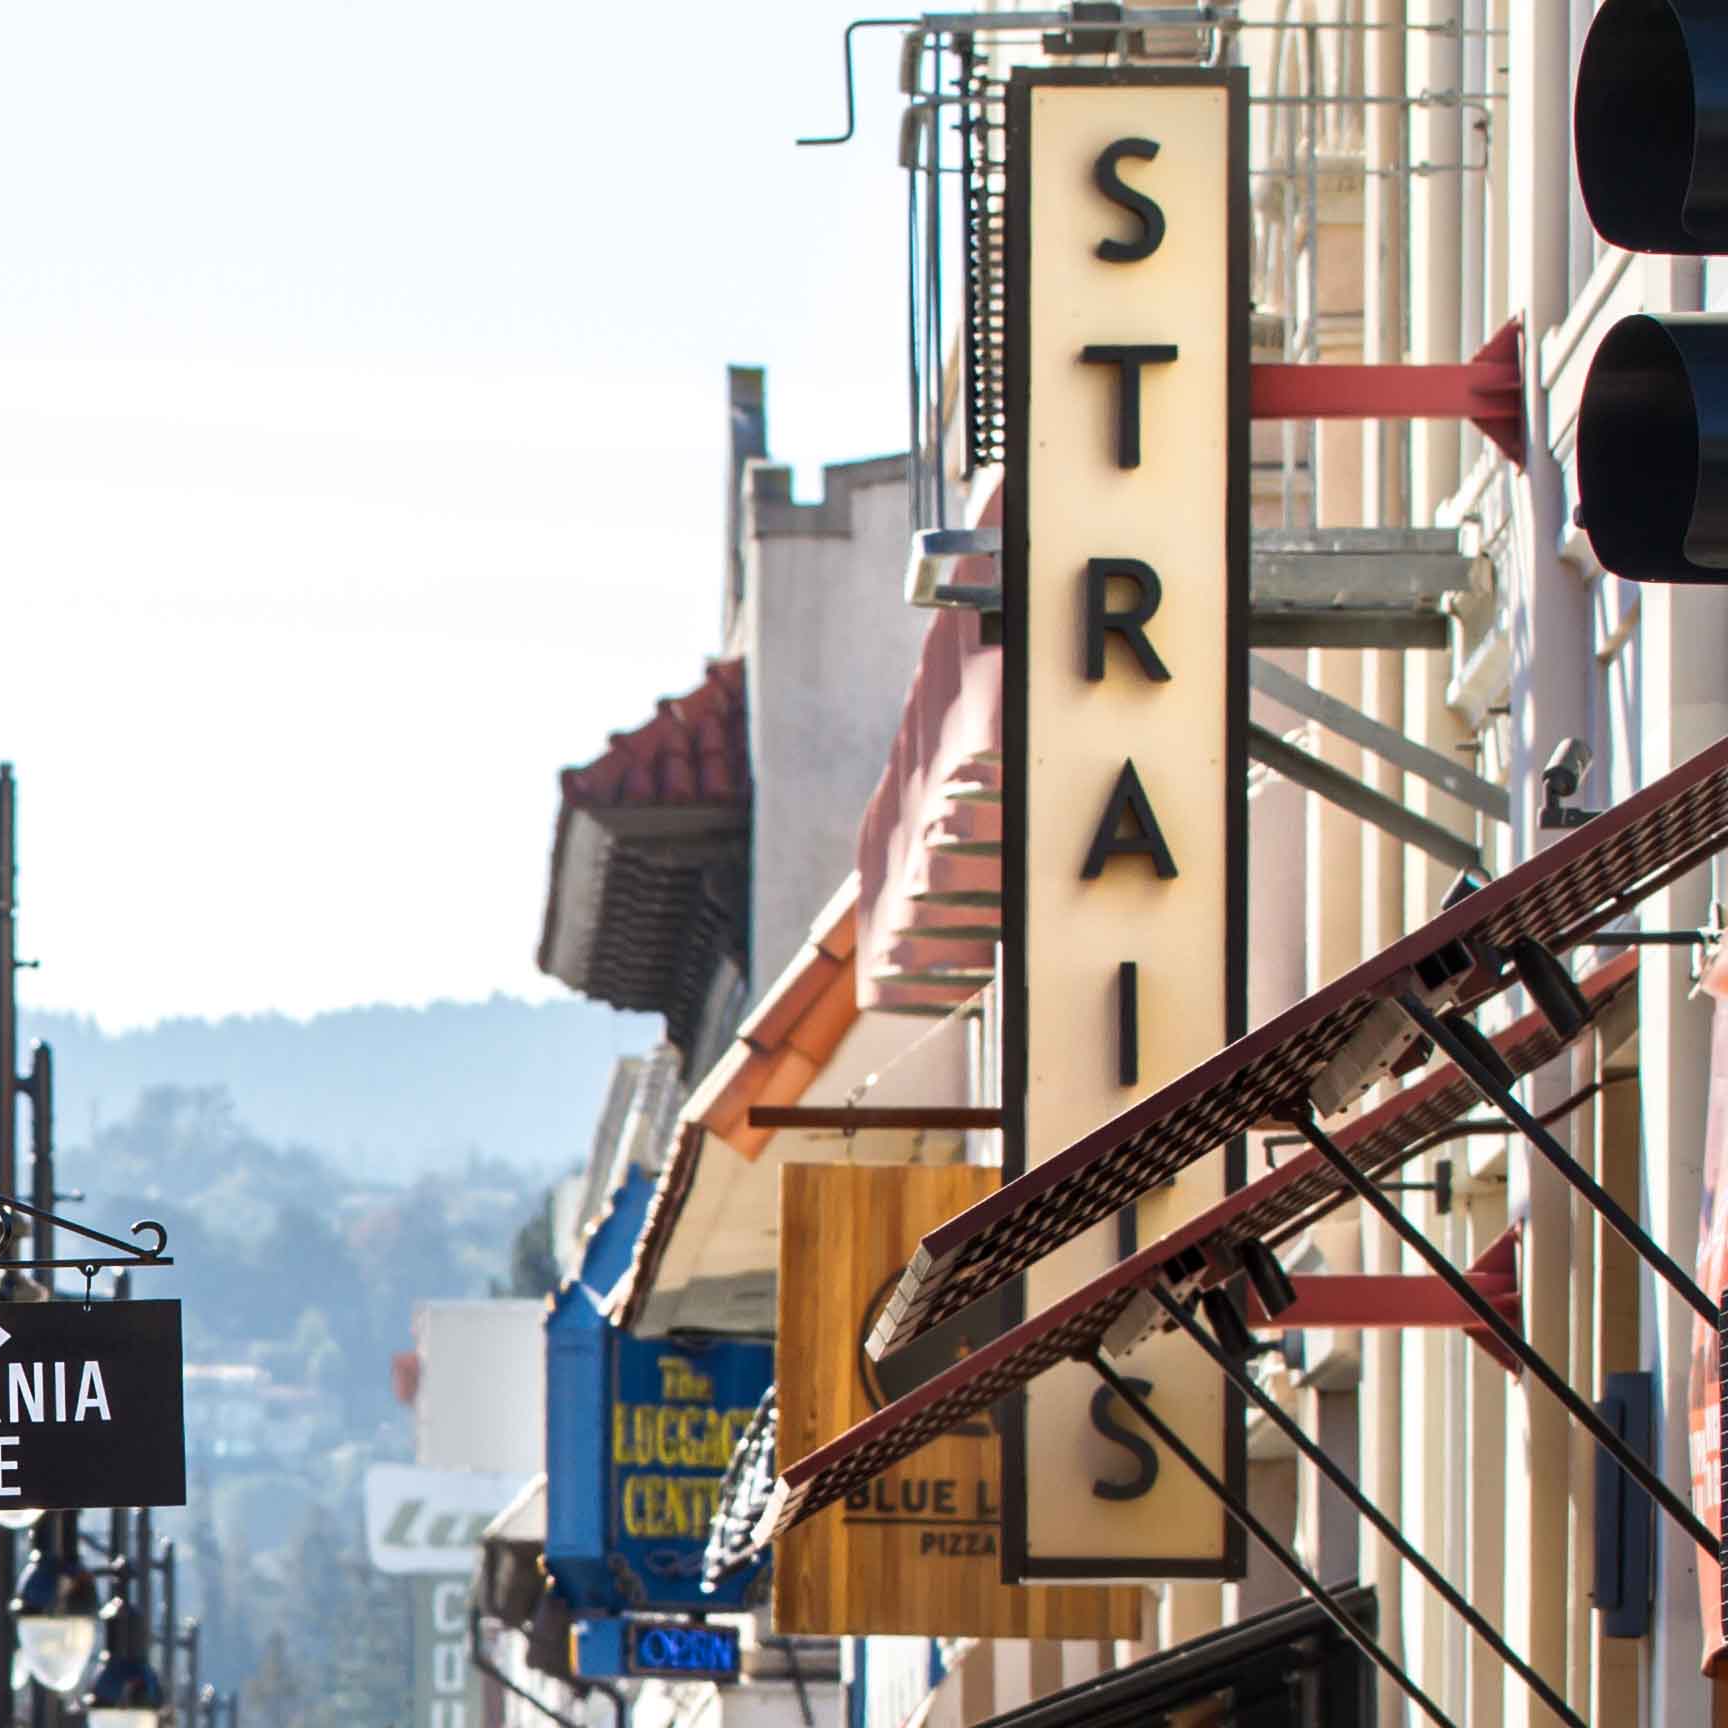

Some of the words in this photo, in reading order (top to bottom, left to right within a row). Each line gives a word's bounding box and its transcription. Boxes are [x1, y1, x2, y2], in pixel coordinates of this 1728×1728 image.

[1079, 136, 1179, 1500] STRAIS
[847, 1478, 958, 1514] BLUE
[921, 1531, 997, 1556] PIZZA
[640, 1630, 732, 1669] OPEN
